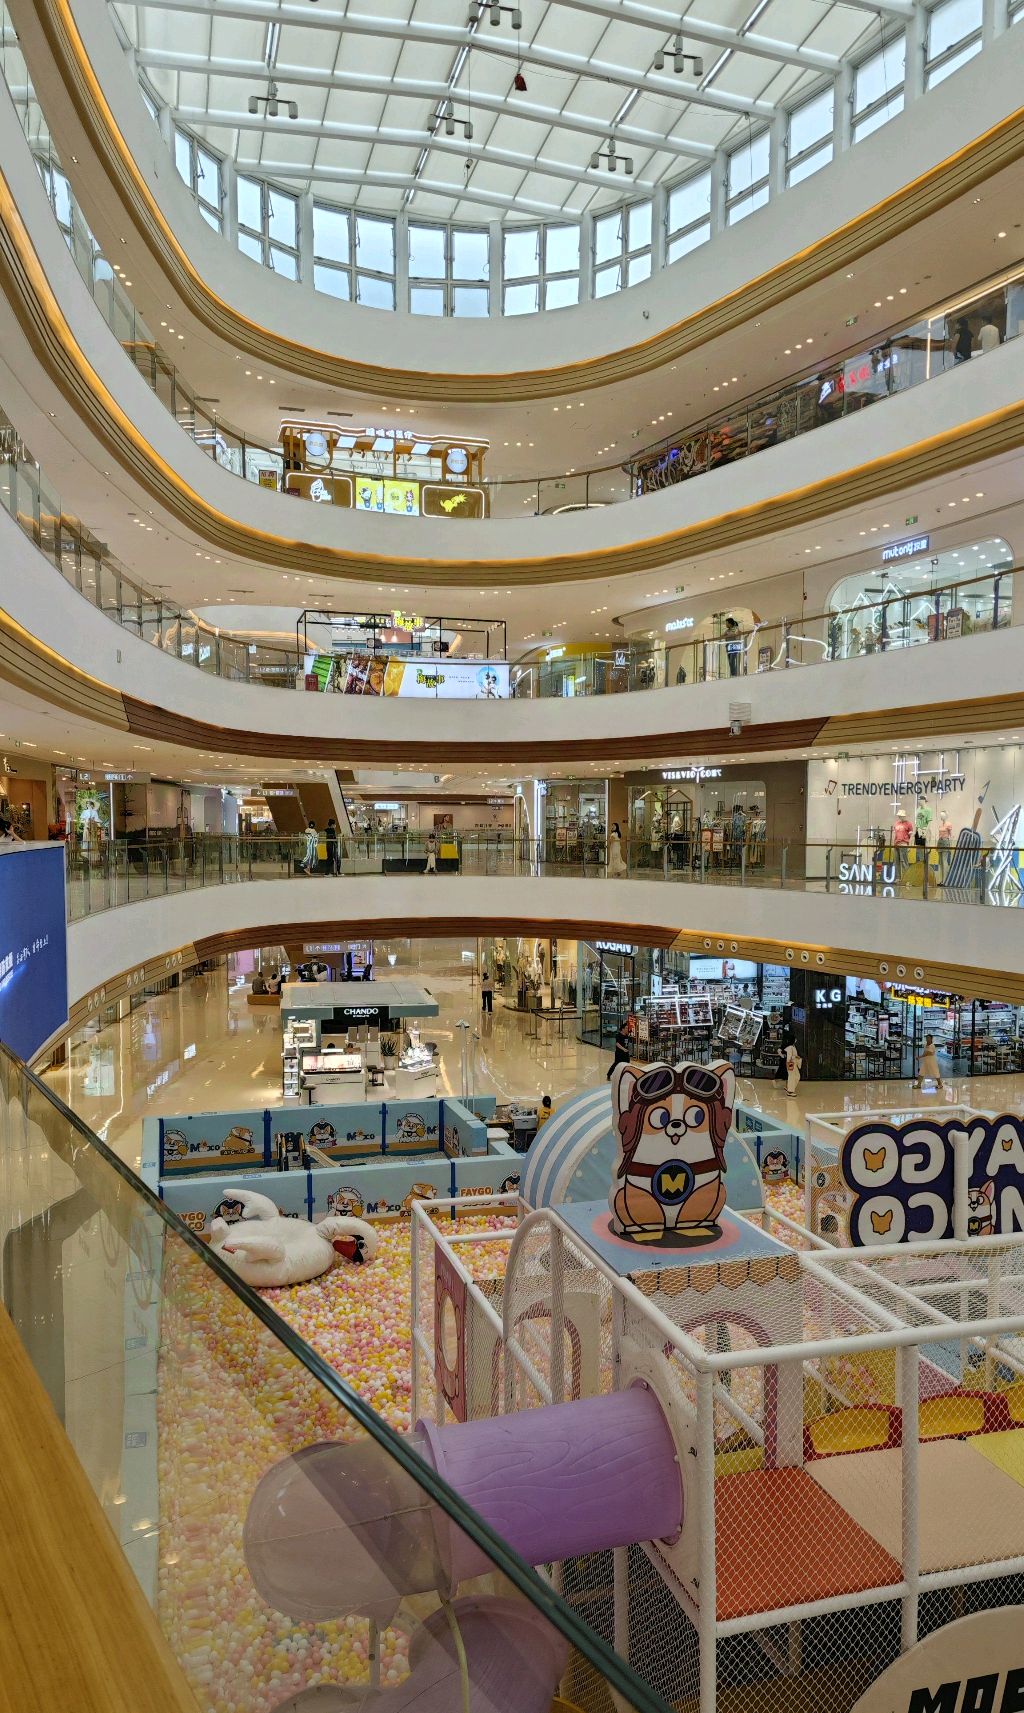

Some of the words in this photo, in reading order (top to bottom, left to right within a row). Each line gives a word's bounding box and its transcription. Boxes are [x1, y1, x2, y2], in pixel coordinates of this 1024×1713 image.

[841, 777, 966, 796] TRENDYENERGYPARTY
[343, 1007, 379, 1016] CHANDO
[460, 1187, 492, 1197] FAYGO
